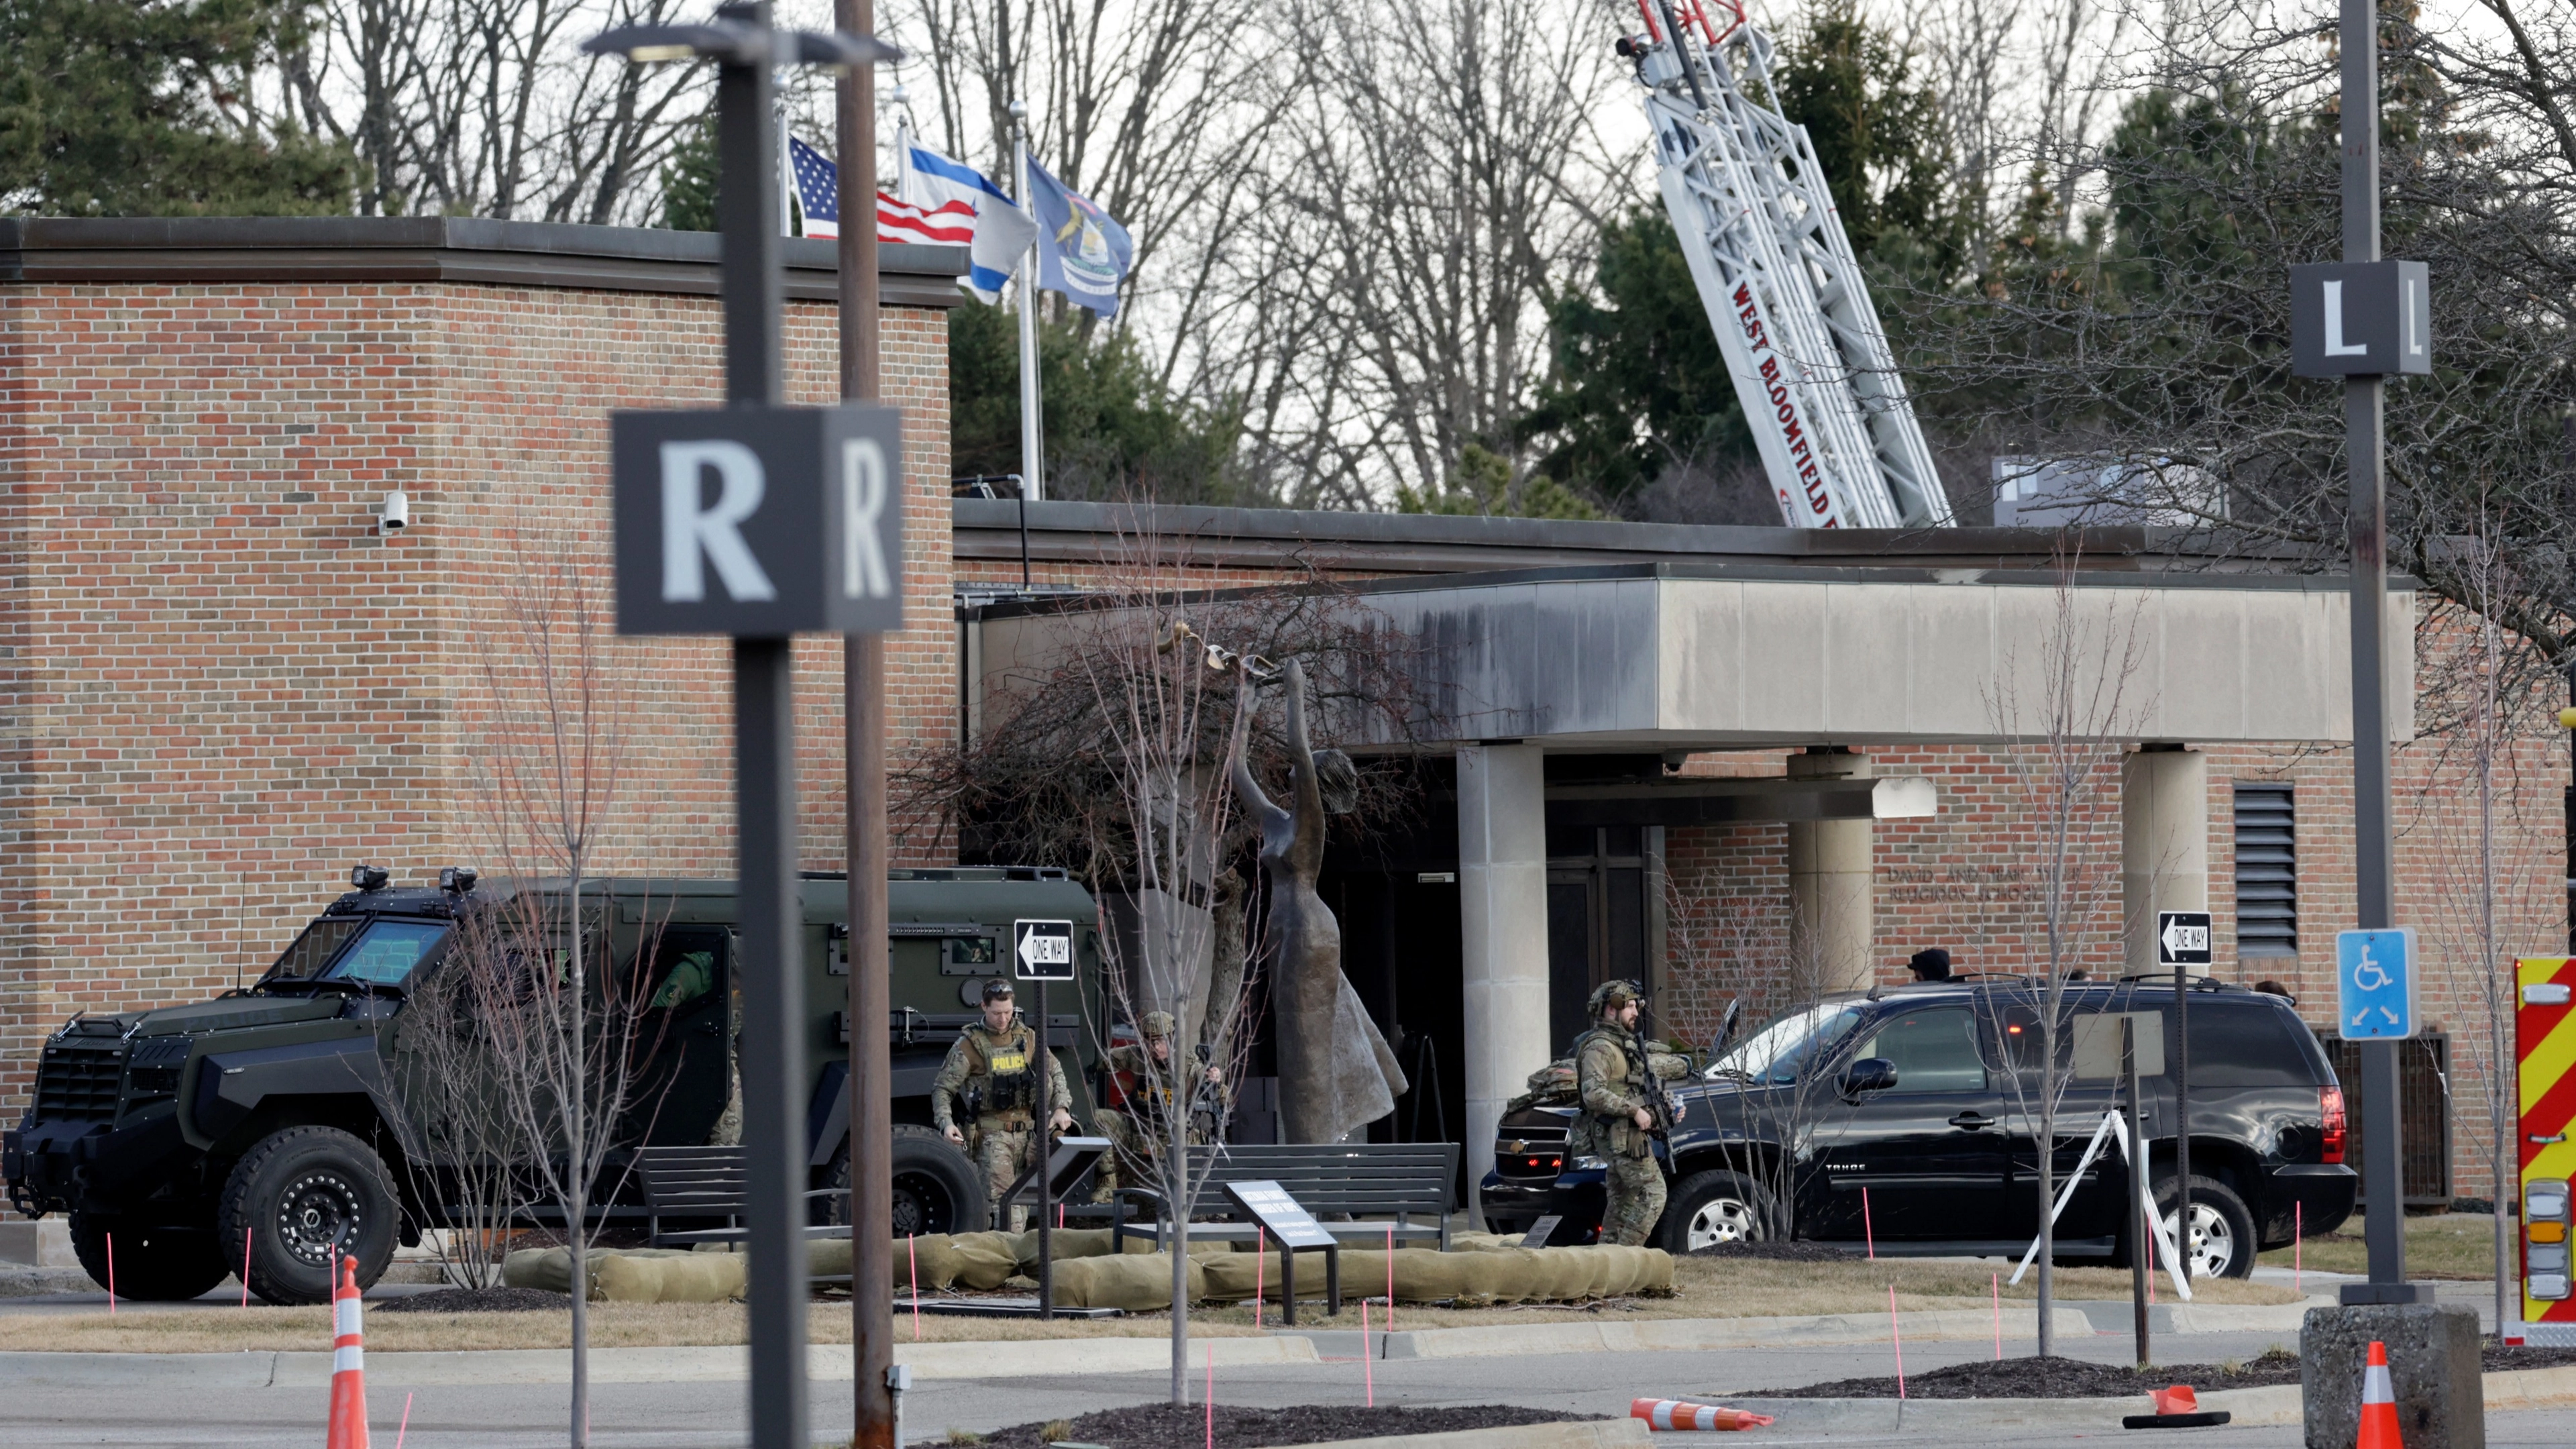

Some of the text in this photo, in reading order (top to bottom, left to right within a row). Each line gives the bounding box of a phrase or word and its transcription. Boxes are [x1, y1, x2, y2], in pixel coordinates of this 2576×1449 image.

[2323, 280, 2367, 357] L
[2408, 279, 2422, 356] L
[1732, 280, 1830, 515] WEST BLOOMFIELD
[659, 438, 778, 602] R
[841, 437, 894, 600] R
[1888, 869, 1934, 882] DAVID
[1947, 868, 1979, 883] AND
[1890, 887, 2041, 902] RELIGIOUS SCHOOL
[2174, 928, 2206, 948] ONE WAY
[1032, 939, 1068, 961] ONE WAY
[184, 1010, 284, 1030] POLICE
[992, 1054, 1025, 1071] POLICE
